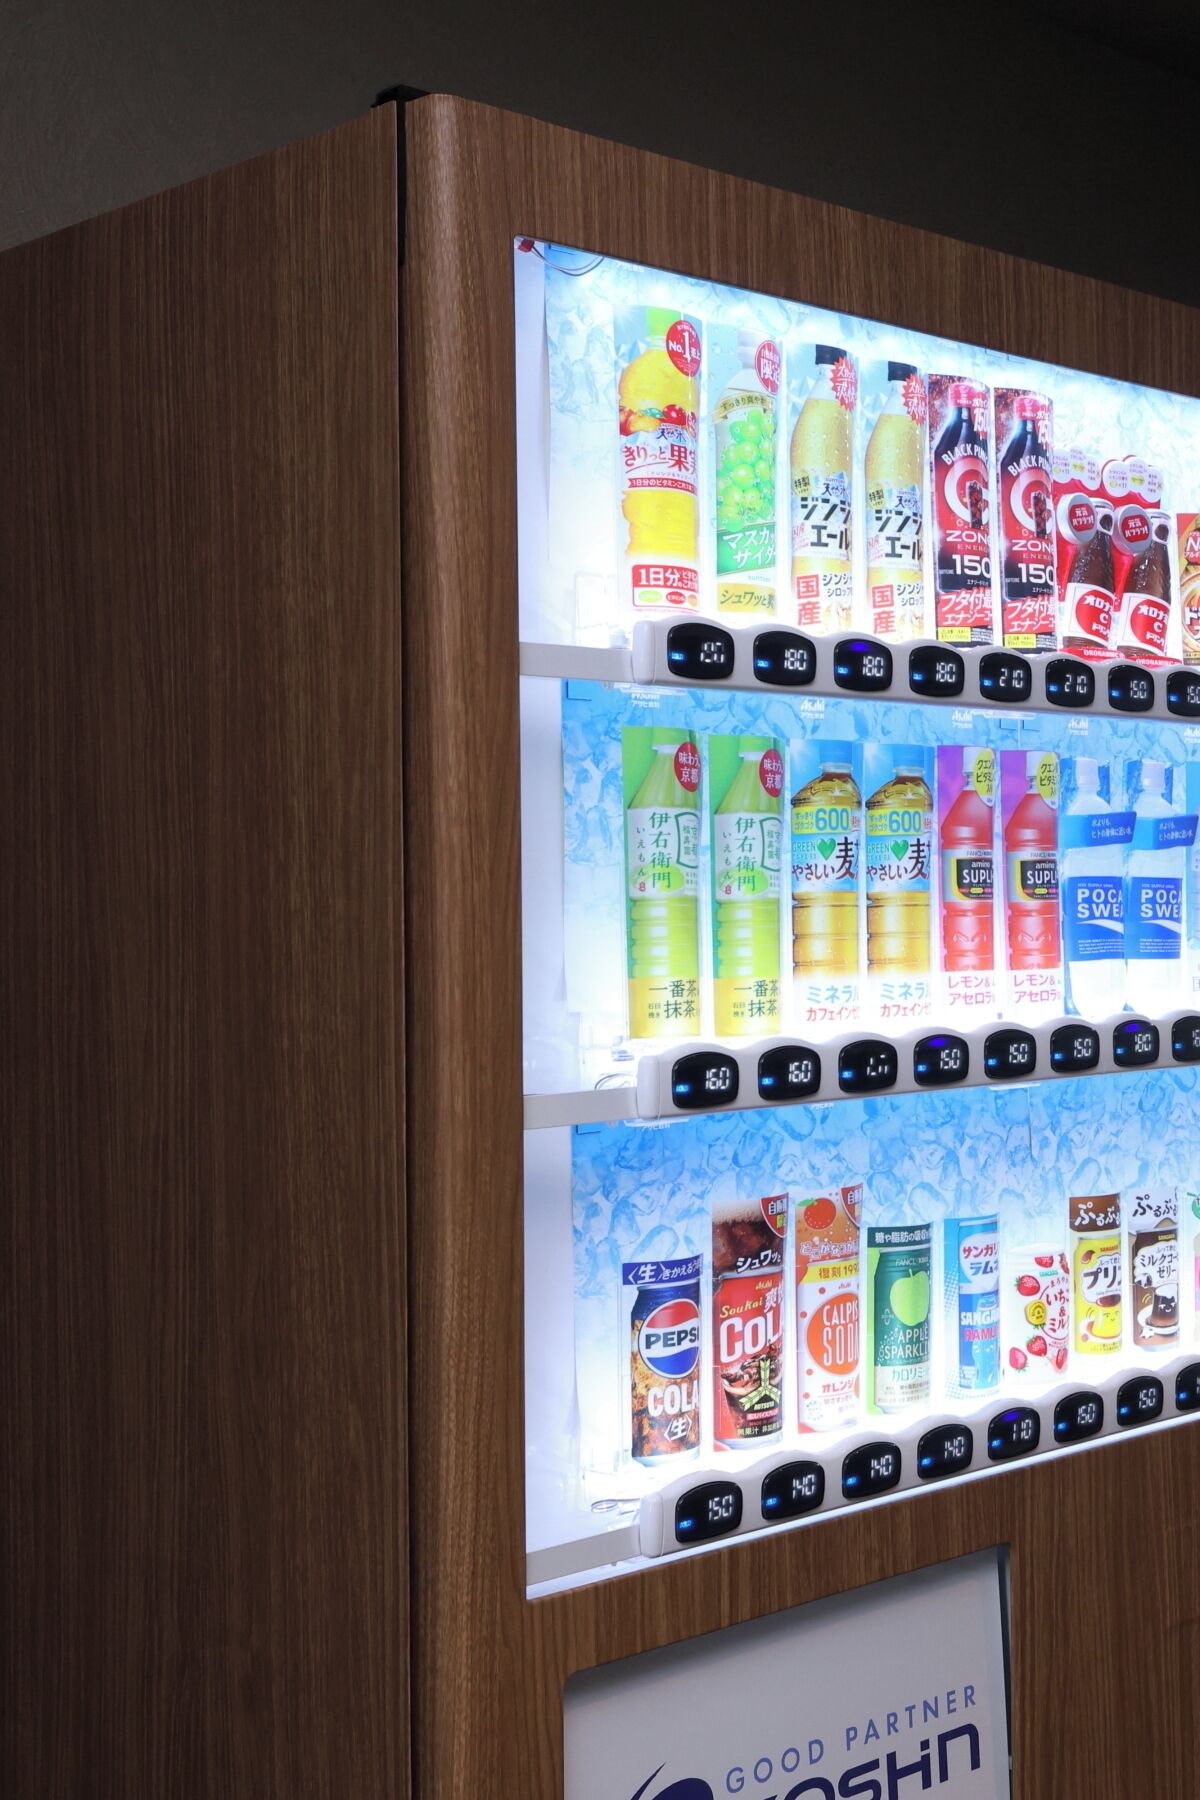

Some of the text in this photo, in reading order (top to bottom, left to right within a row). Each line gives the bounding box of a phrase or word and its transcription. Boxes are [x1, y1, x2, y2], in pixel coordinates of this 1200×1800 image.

[941, 443, 973, 466] BLACK
[1007, 454, 1037, 476] BLACK
[796, 574, 822, 626] 国産
[871, 584, 896, 635] 国産
[1099, 612, 1109, 624] C
[1153, 622, 1163, 633] C
[784, 648, 807, 670] 180
[862, 655, 884, 677] 180
[680, 767, 699, 785] 京都
[764, 773, 783, 790] 京都
[814, 807, 850, 832] 600
[888, 809, 923, 833] 600
[648, 811, 673, 889] 伊右衛門
[734, 816, 757, 892] 伊右衛門
[792, 840, 816, 852] GREEN
[867, 841, 890, 853] GREEN
[791, 863, 836, 882] やさしい
[866, 864, 909, 882] やさしい
[648, 979, 697, 999] 一番茶
[734, 979, 779, 998] 一番茶
[664, 999, 697, 1019] 抹茶
[749, 999, 777, 1018] 抹茶
[1009, 1043, 1028, 1064] 150
[1073, 1038, 1092, 1058] 150
[940, 1049, 960, 1070] 150
[705, 1067, 729, 1090] 160
[788, 1061, 812, 1082] 160
[647, 1380, 699, 1417] COLA
[1138, 1388, 1157, 1409] 150
[1077, 1403, 1096, 1425] 150
[1012, 1419, 1032, 1441] 110
[944, 1436, 965, 1460] 140
[870, 1455, 893, 1480] 140
[791, 1474, 816, 1499] 140
[708, 1494, 733, 1521] 150
[725, 1684, 977, 1794] GOOD PARTNER
